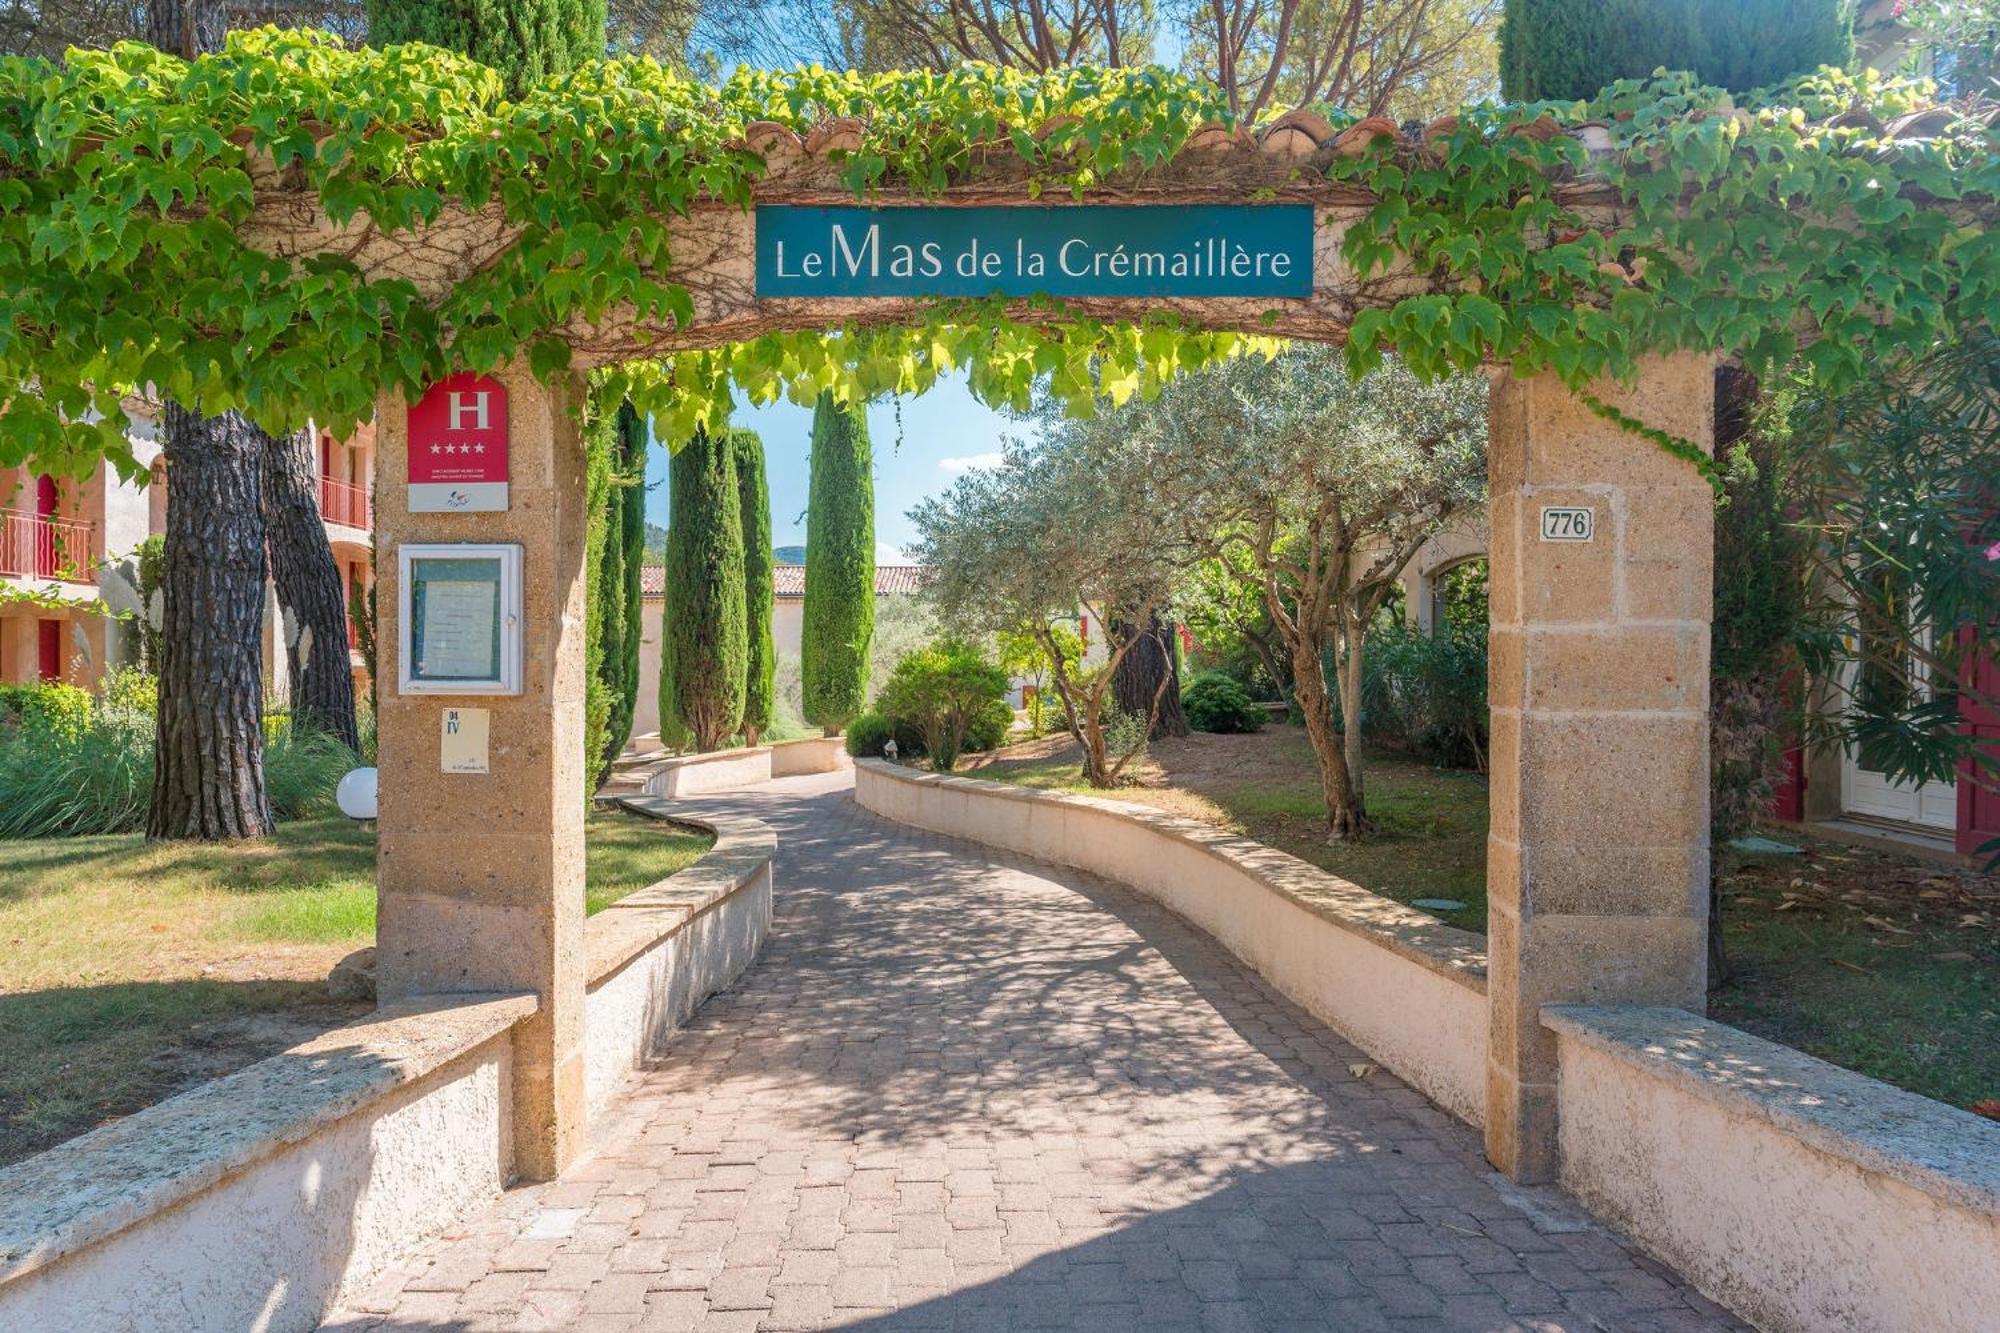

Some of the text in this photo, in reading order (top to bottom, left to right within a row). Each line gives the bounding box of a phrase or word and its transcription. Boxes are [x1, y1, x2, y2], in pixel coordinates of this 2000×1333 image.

[776, 224, 1291, 277] Le Mas de la Crémaillère
[445, 391, 493, 430] H
[1548, 512, 1586, 535] 776
